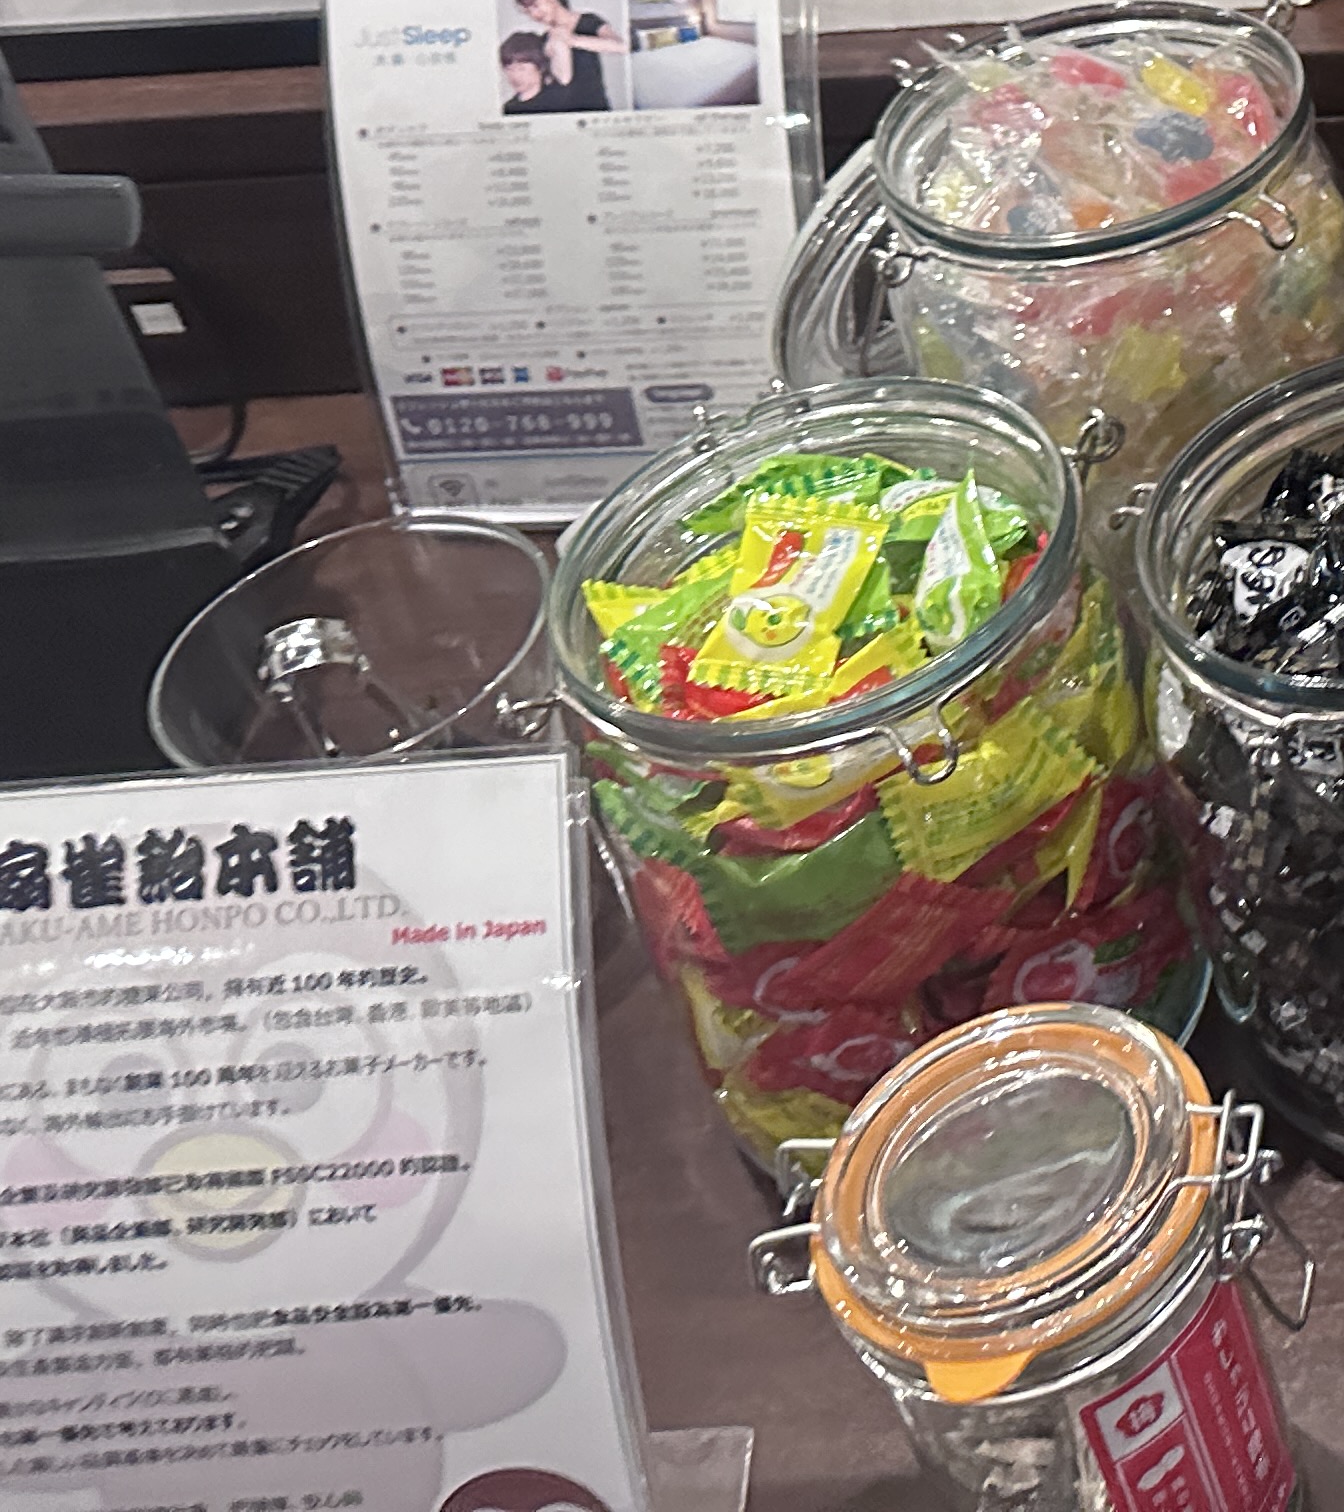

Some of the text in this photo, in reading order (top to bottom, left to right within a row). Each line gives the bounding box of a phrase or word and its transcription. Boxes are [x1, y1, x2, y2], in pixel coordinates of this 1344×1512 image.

[151, 899, 267, 936] HONPO
[392, 919, 546, 945] Made in Japan
